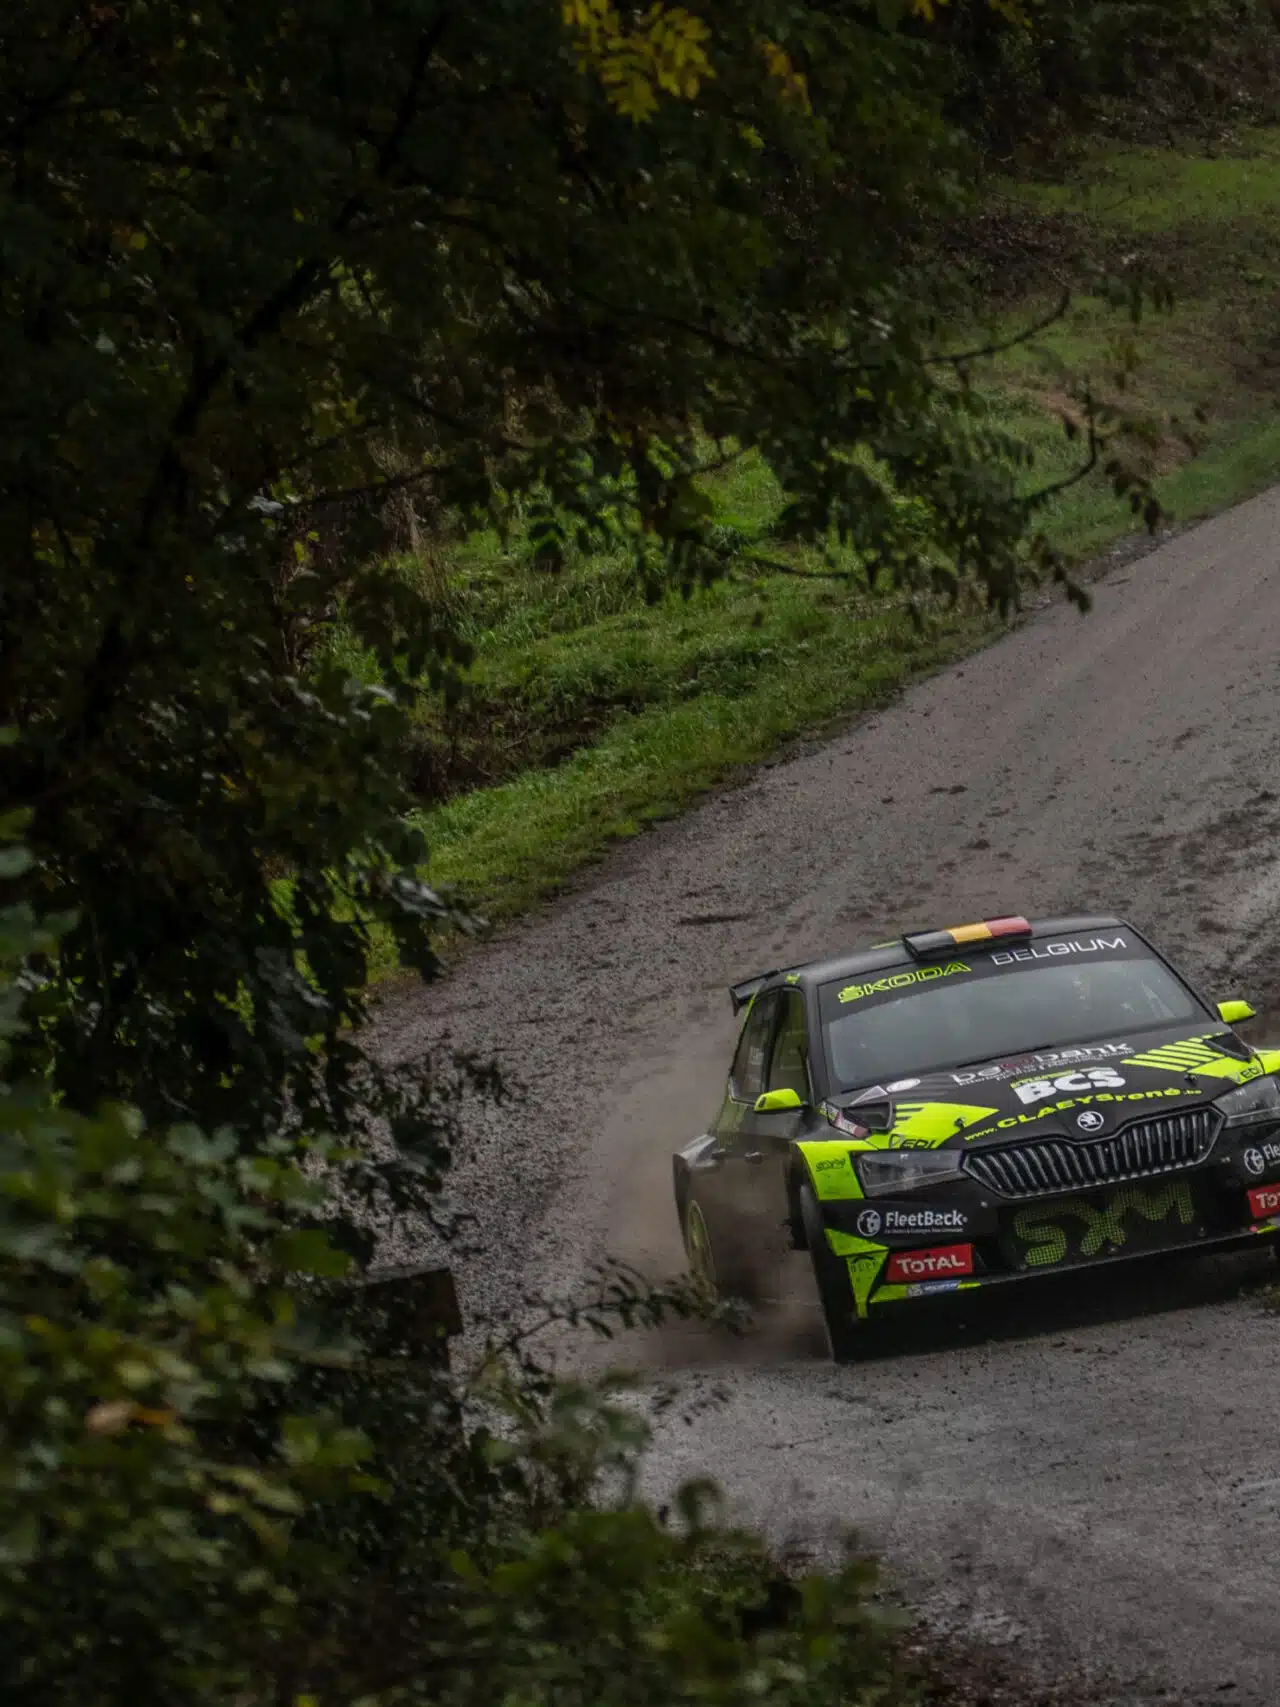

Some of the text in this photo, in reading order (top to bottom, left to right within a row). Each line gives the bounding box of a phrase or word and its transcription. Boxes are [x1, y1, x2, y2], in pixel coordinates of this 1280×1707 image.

[991, 938, 1127, 966] BELGIUM
[1013, 1069, 1126, 1104] BCS
[886, 1210, 964, 1227] FleetBack
[1014, 1182, 1194, 1266] SXM
[896, 1254, 966, 1275] TOTAL
